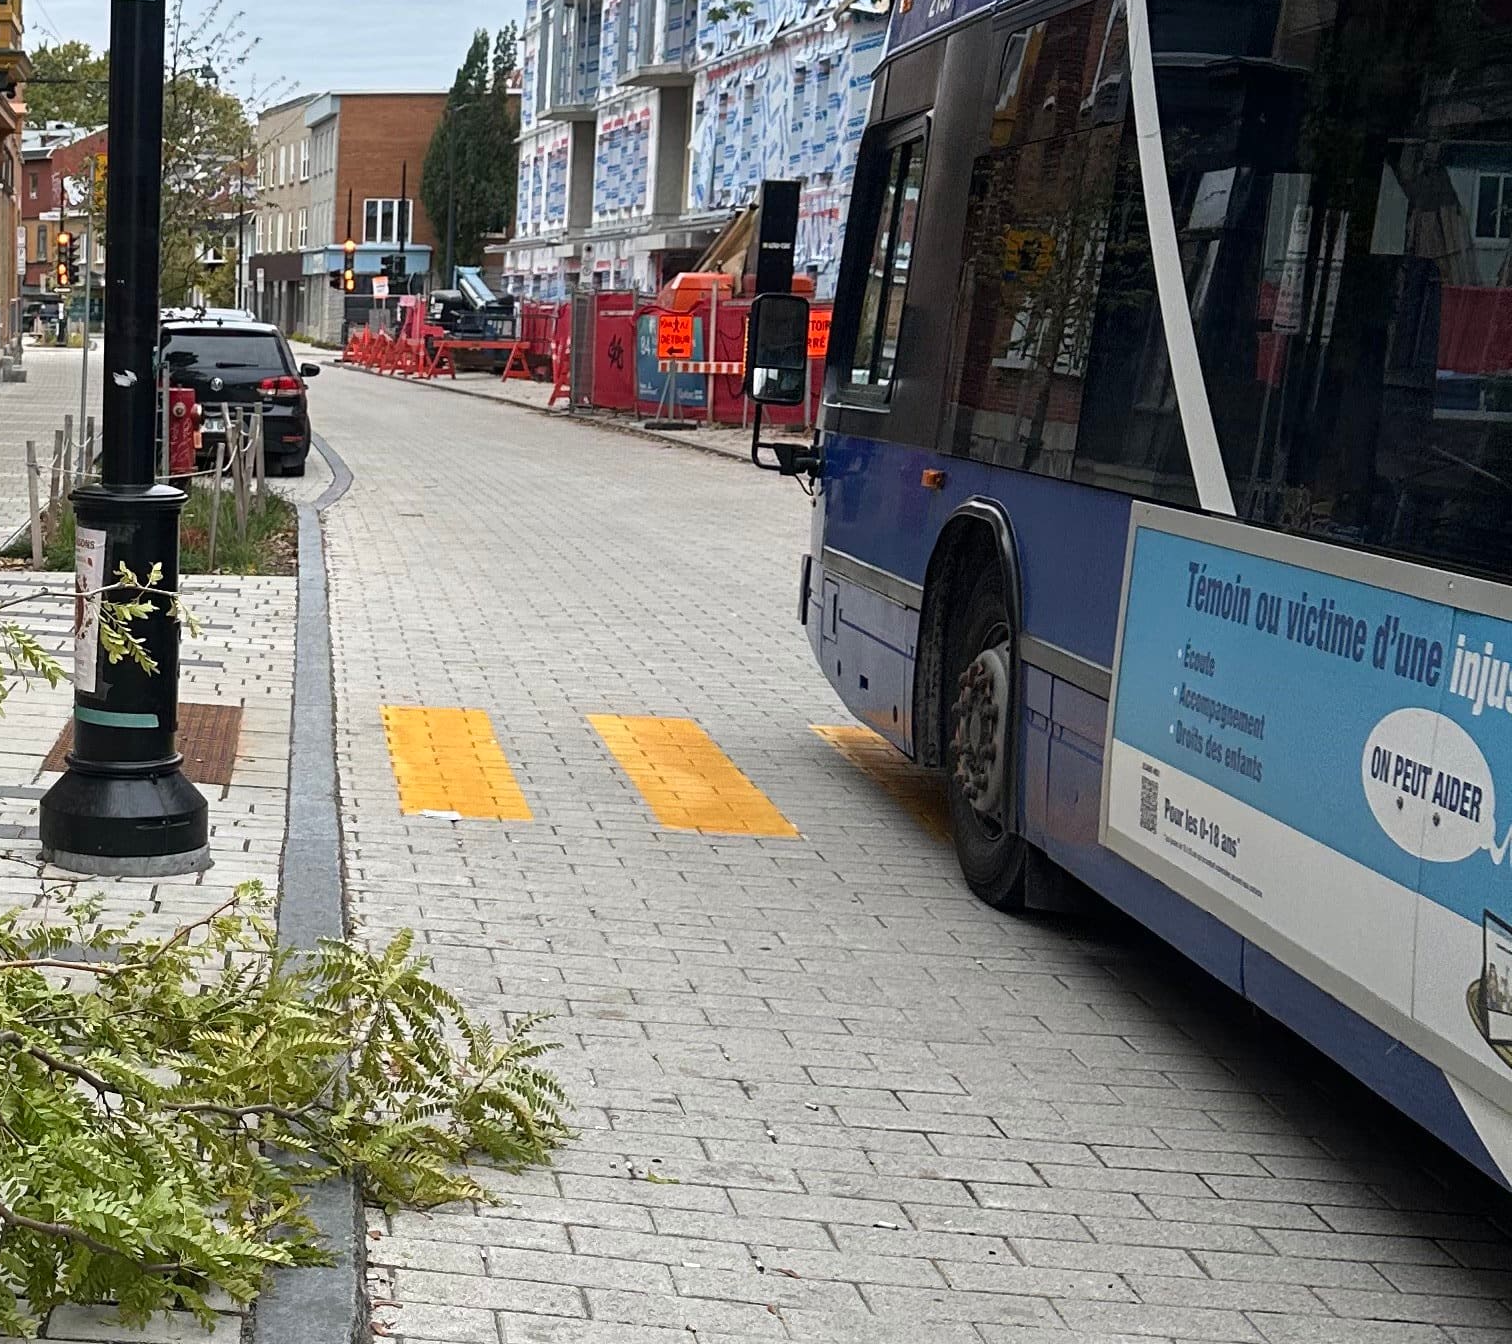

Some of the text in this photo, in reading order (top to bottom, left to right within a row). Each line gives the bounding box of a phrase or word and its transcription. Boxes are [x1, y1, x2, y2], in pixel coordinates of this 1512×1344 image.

[1186, 561, 1251, 626] Témoin
[1256, 592, 1282, 635] ou
[1286, 592, 1368, 662] victime
[1372, 614, 1443, 687] d'une
[1184, 637, 1216, 677] Écoute
[1179, 682, 1265, 741] Accompagnement
[1175, 719, 1263, 783] Droits des enfants
[1371, 745, 1483, 823] ON PEUT AIDER
[1164, 797, 1184, 828] Pour
[1184, 808, 1198, 836] les
[1199, 817, 1220, 848] 0-18
